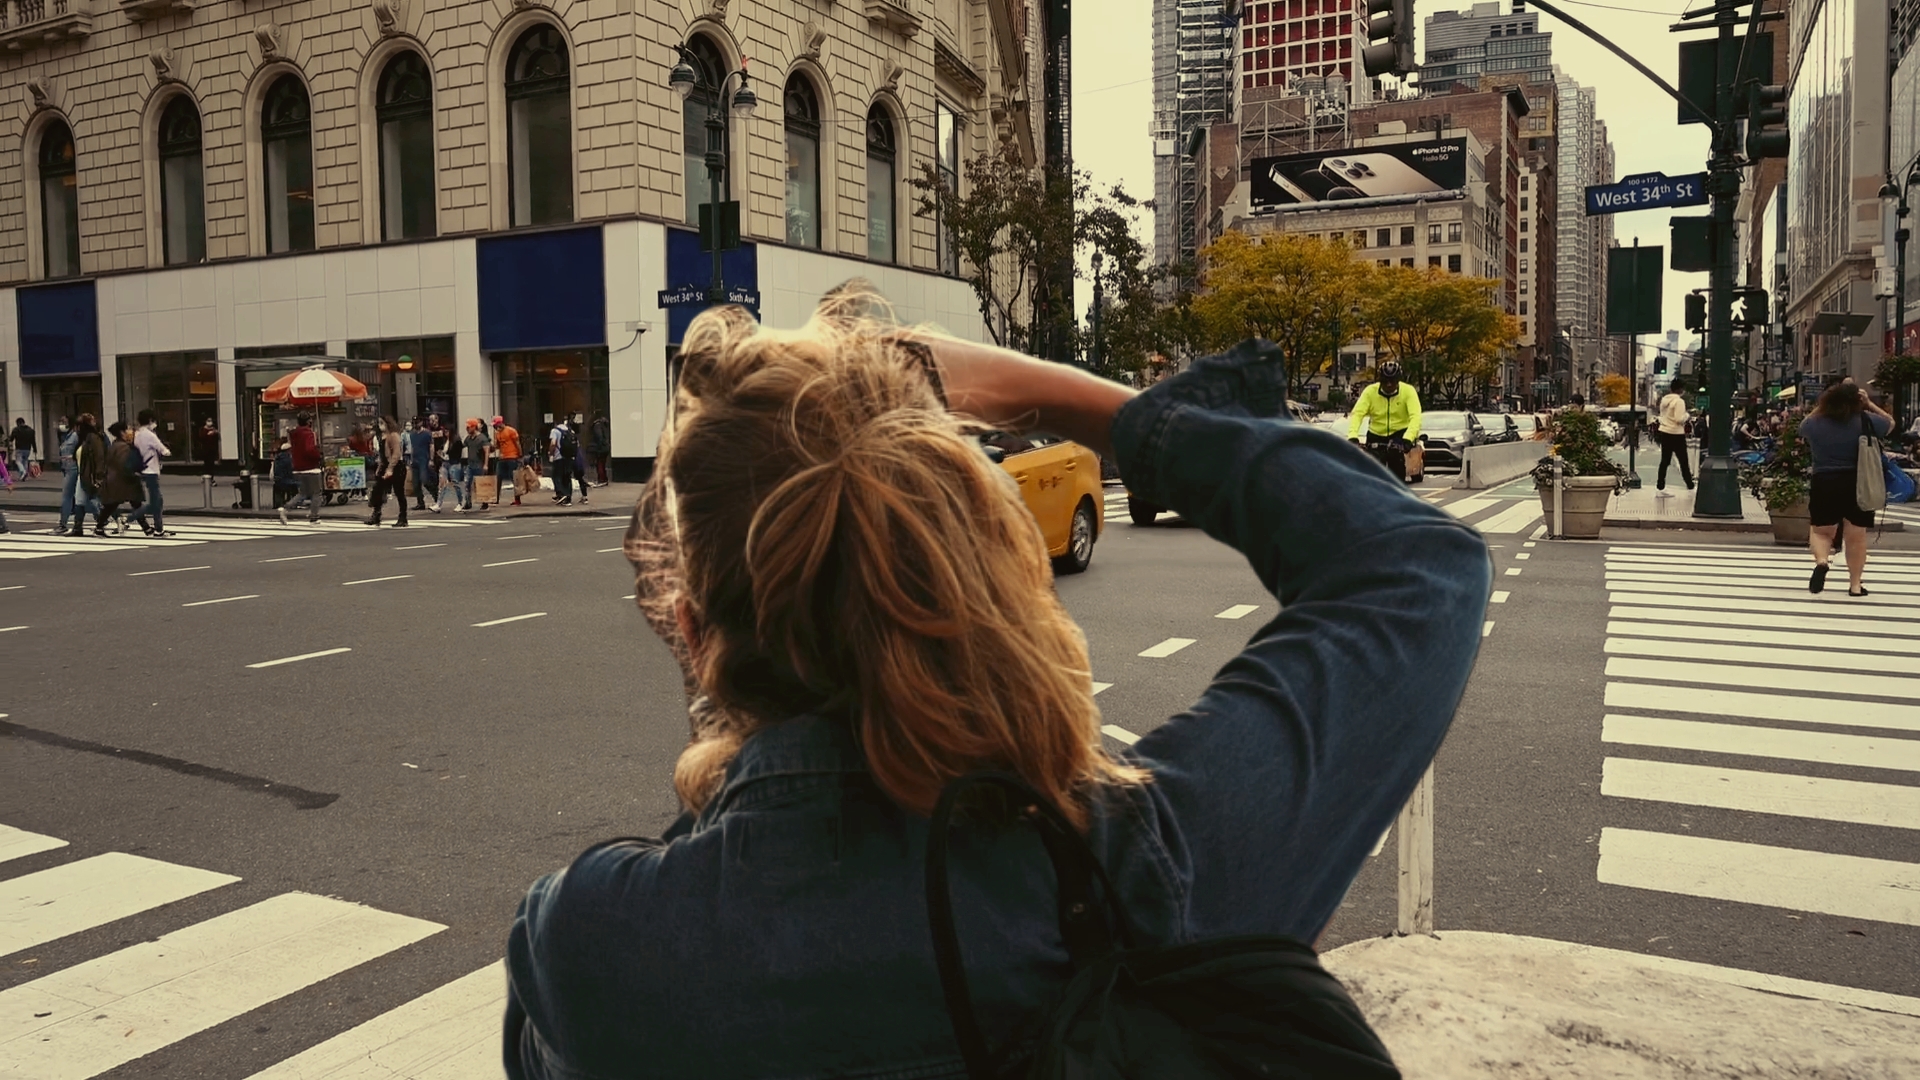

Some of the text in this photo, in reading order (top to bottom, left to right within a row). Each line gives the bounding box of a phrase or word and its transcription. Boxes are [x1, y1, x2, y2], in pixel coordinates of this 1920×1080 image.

[1418, 147, 1440, 155] iPhone
[1440, 145, 1447, 153] 12
[1422, 153, 1449, 162] Hello 5G
[1595, 183, 1693, 207] West 34th St
[662, 291, 704, 304] West 34th St
[729, 291, 756, 304] Sixth Ave
